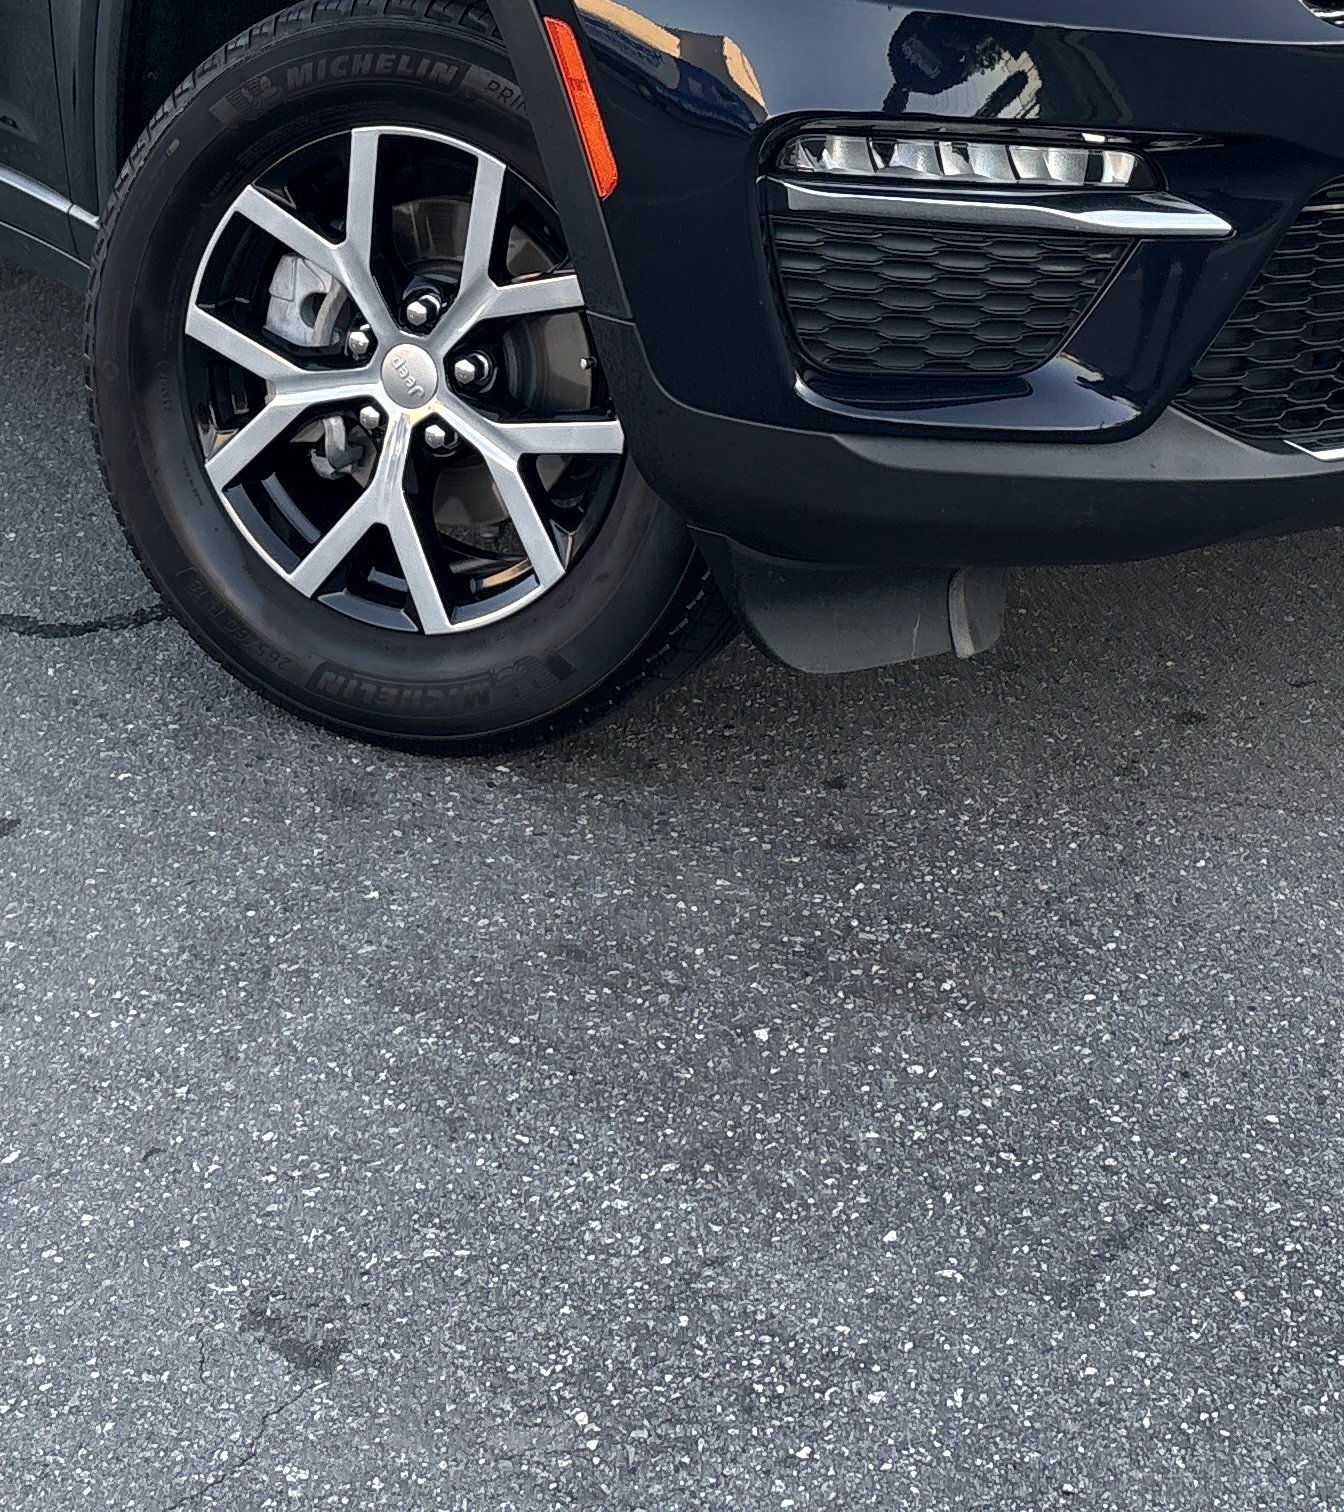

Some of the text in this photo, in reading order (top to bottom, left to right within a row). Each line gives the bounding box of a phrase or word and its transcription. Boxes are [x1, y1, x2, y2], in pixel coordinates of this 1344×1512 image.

[286, 54, 458, 89] MICHELIN
[392, 355, 425, 397] Jeep
[316, 671, 492, 710] MICHELIN
